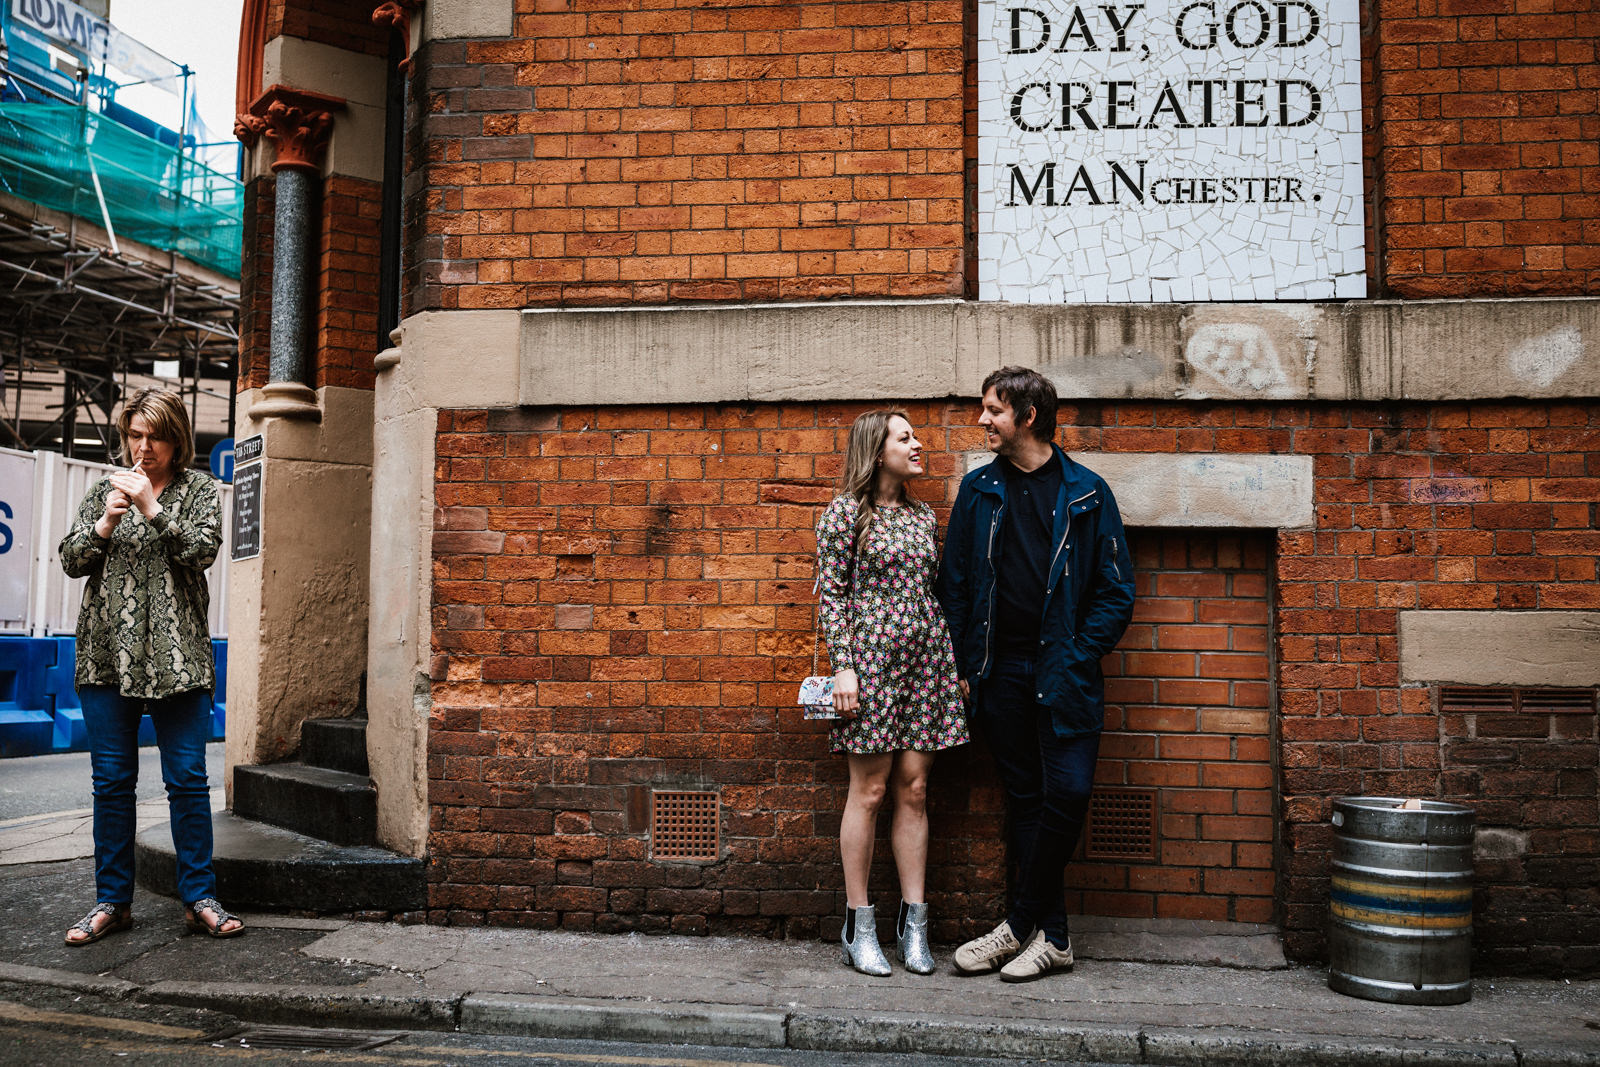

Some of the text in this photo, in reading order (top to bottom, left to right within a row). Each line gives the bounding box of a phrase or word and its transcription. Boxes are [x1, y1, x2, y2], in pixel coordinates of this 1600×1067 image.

[1007, 1, 1320, 61] DAY, GOD
[1010, 79, 1322, 132] CREATED
[244, 439, 260, 455] STREET
